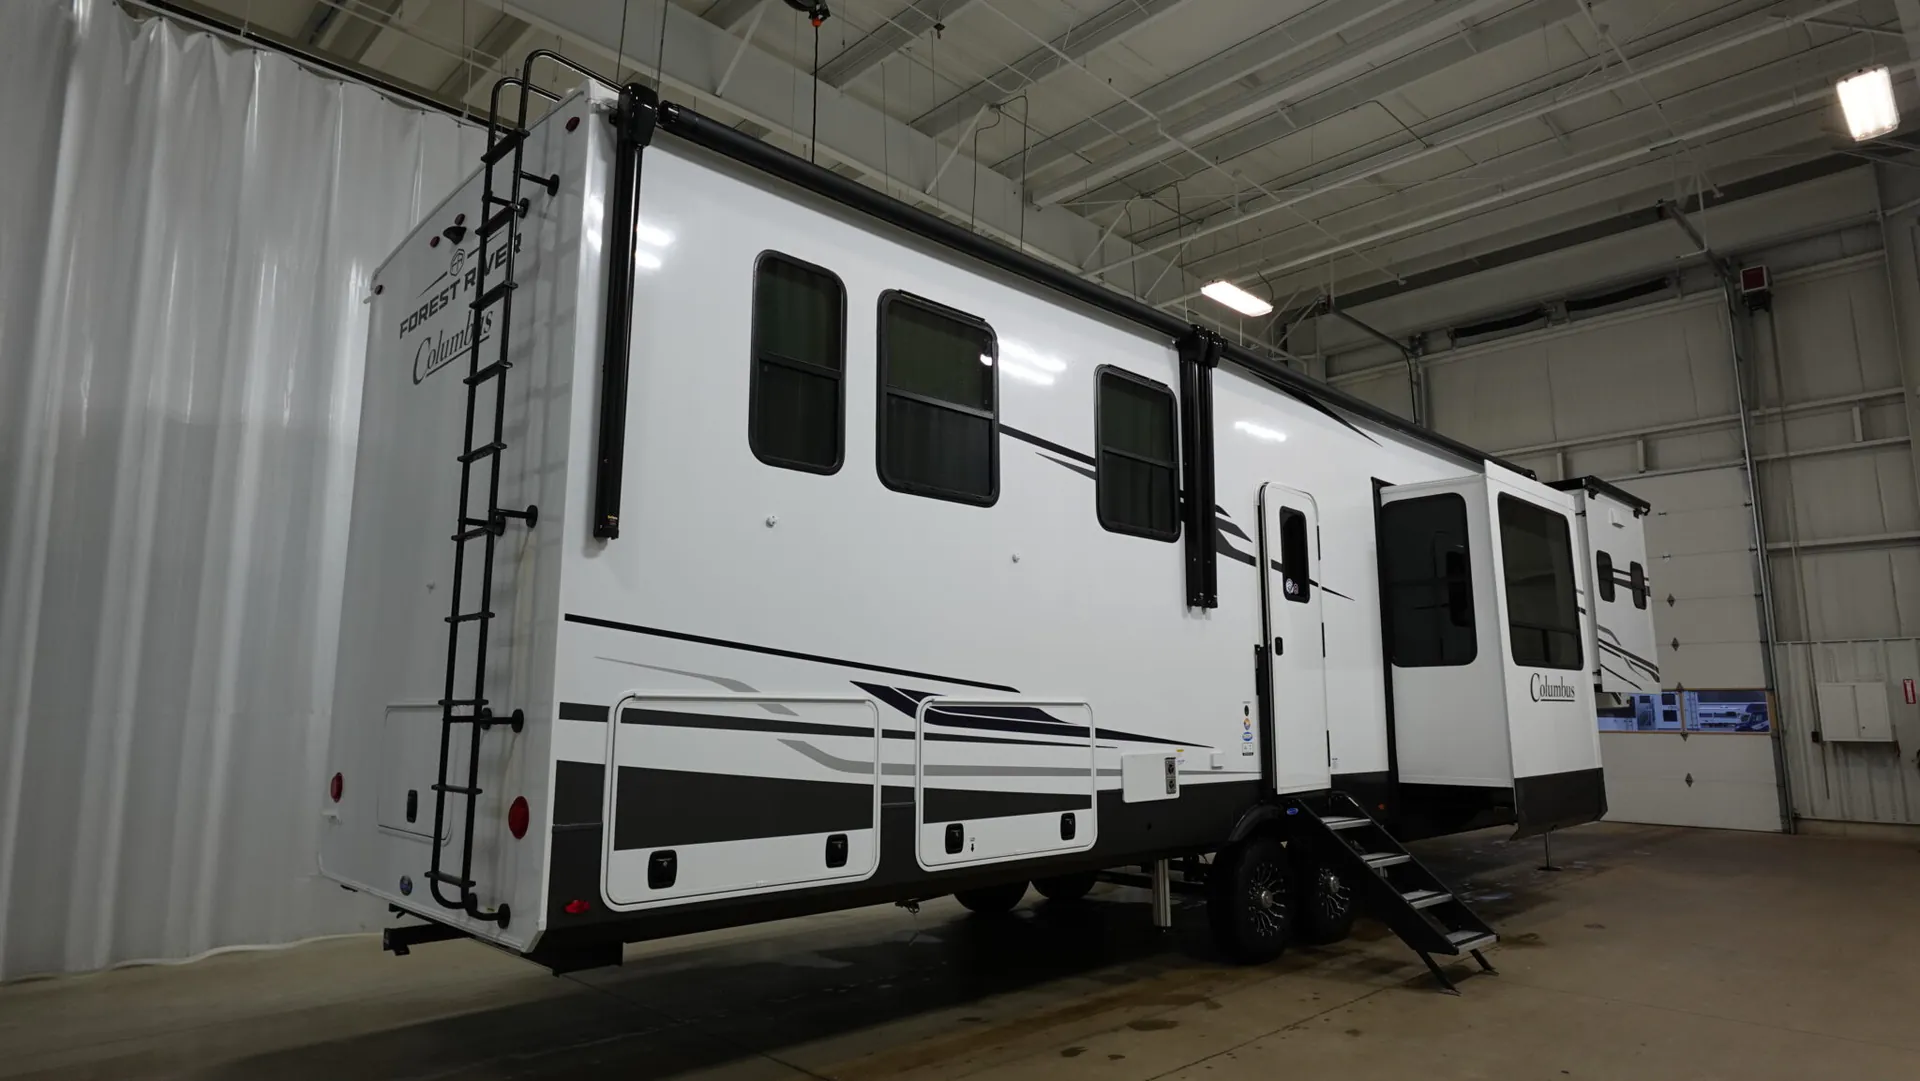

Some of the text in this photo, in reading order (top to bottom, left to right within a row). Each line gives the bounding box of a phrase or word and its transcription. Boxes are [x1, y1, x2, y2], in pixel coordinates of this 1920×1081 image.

[400, 233, 522, 339] FOREST RVER
[1530, 673, 1575, 702] Columbus
